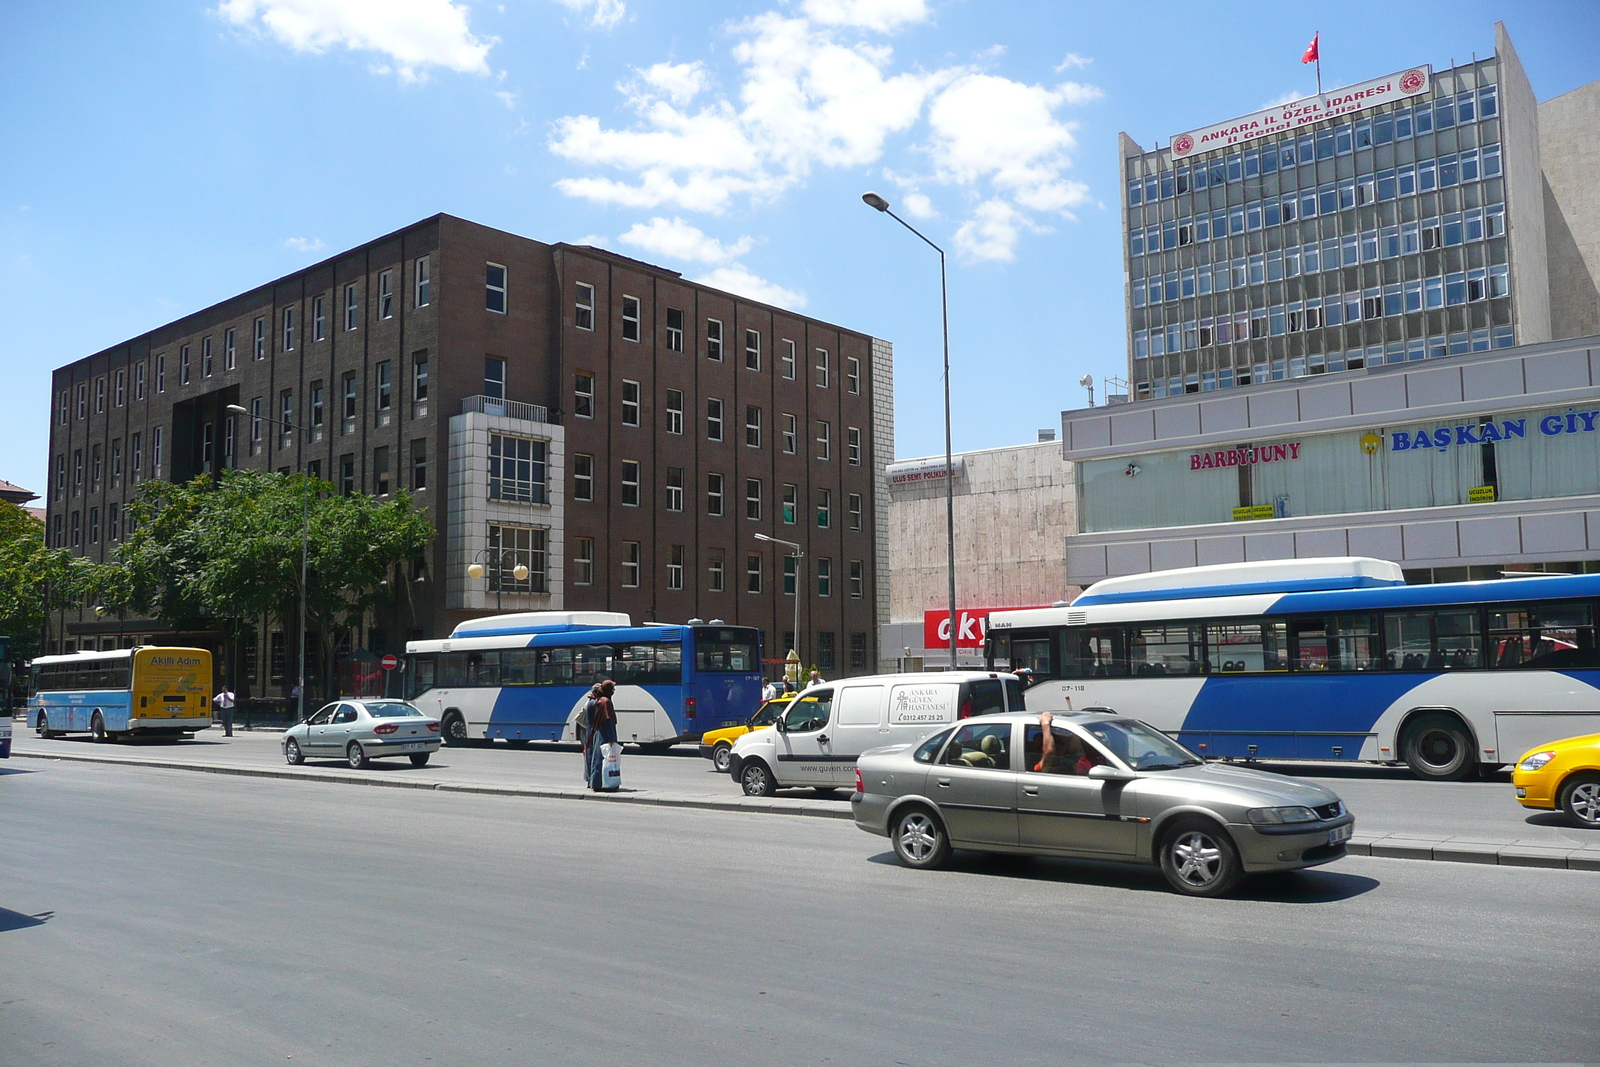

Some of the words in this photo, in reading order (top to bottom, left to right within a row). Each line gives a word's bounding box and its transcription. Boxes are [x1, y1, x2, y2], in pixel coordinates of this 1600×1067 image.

[1200, 120, 1260, 143] ANKARA
[1264, 115, 1278, 126] İL
[1282, 104, 1322, 120] ÖZEL
[1326, 82, 1392, 109] İDARESİ
[1282, 103, 1300, 111] T.C.
[1243, 121, 1291, 139] Genel
[1297, 102, 1362, 126] Meclisi
[1391, 418, 1527, 453] BAŞKAN
[1539, 407, 1600, 437] GİY
[1190, 442, 1301, 471] BARBYJUNY
[892, 474, 907, 483] ULUS
[907, 472, 922, 482] SEMT
[177, 656, 200, 665] Adım
[908, 702, 946, 711] HASTANESİ
